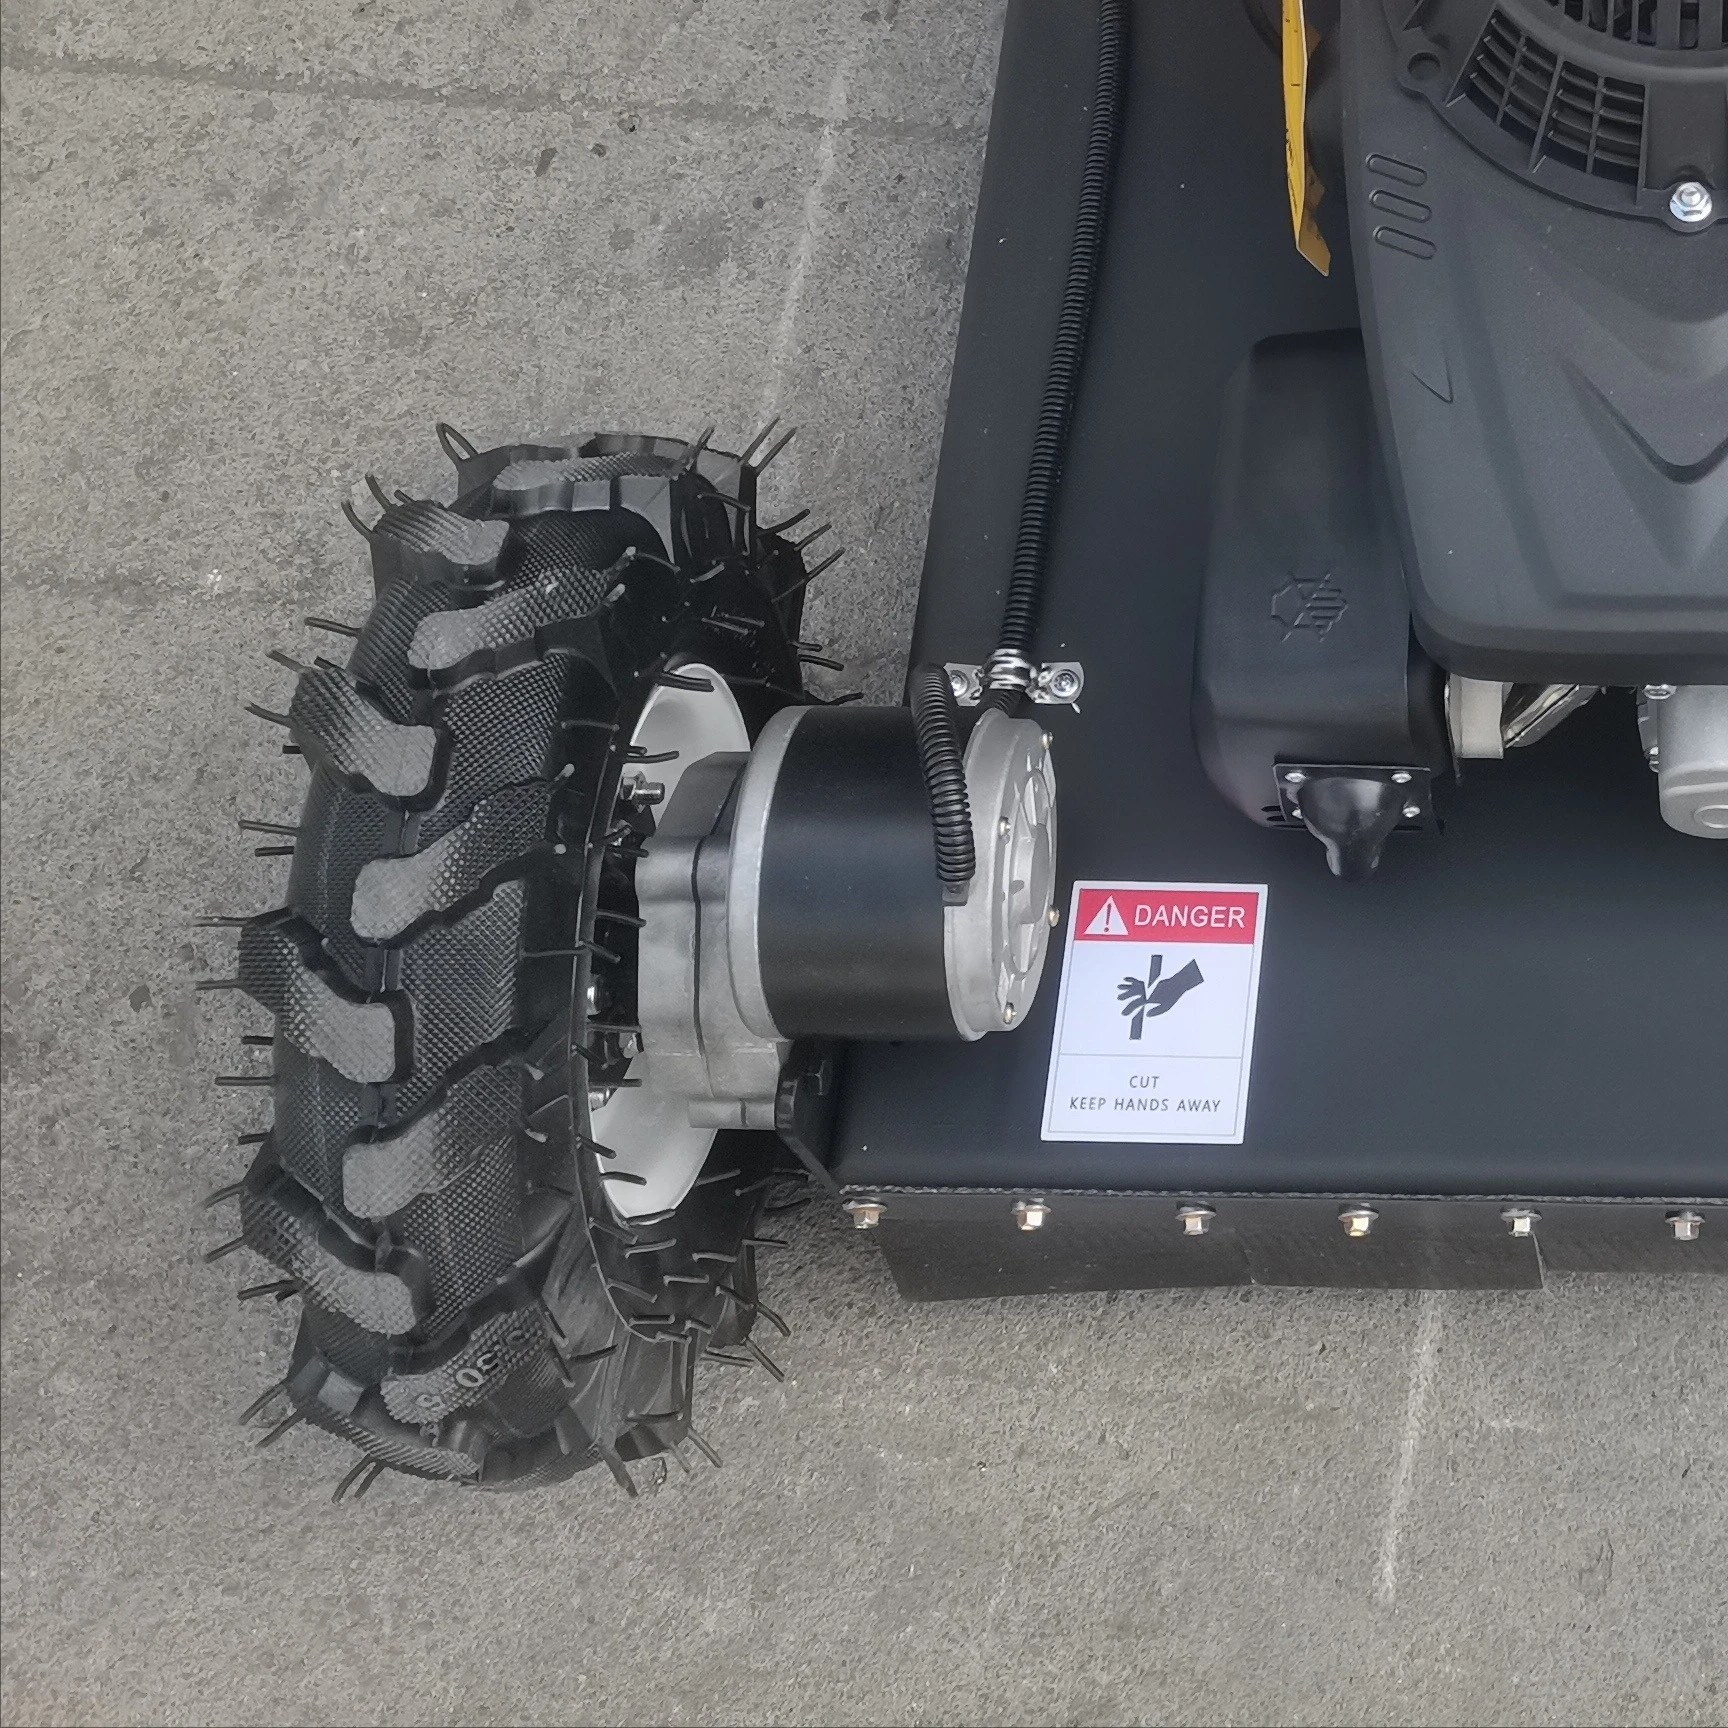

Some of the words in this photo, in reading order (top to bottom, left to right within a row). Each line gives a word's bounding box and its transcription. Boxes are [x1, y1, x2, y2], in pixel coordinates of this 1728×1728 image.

[1134, 904, 1246, 929] DANGER
[1129, 1075, 1160, 1089] CUT
[1069, 1096, 1107, 1110] KEEP
[1113, 1097, 1169, 1112] HANDS
[1176, 1098, 1222, 1113] AWAY
